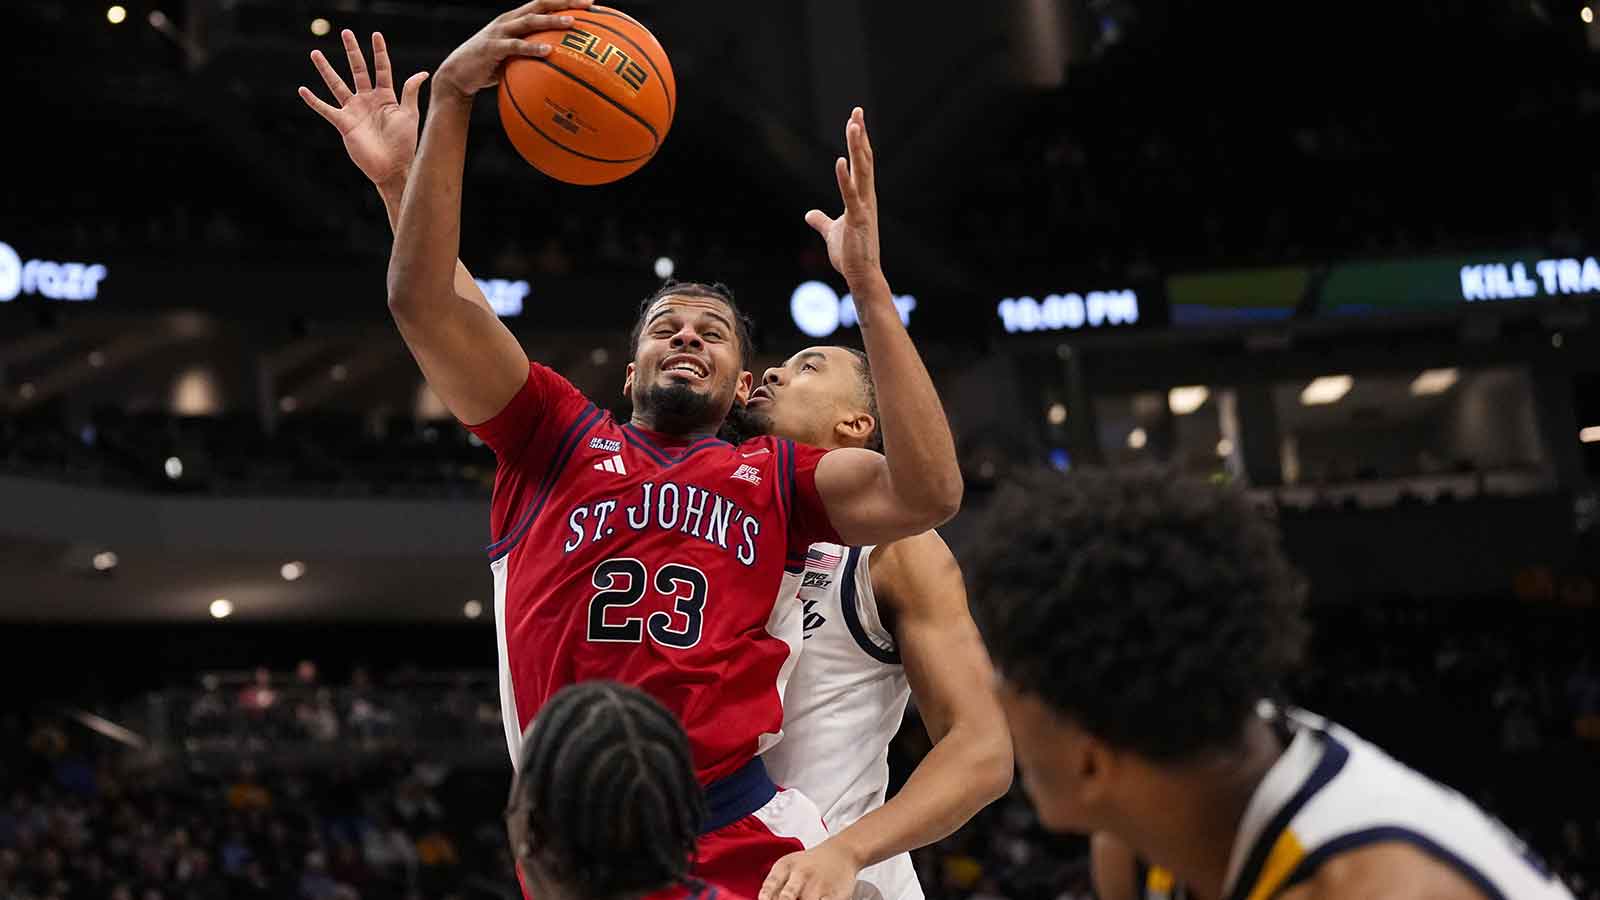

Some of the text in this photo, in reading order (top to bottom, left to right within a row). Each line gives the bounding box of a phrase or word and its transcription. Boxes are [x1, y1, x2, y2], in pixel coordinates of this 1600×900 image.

[560, 30, 648, 92] ELITE
[1460, 262, 1537, 301] KILL
[1086, 289, 1138, 327] PM
[732, 470, 762, 483] EAST
[739, 464, 760, 475] BIG
[564, 482, 760, 566] ST. JOHN'S
[803, 572, 829, 581] BIG
[586, 557, 708, 649] 23
